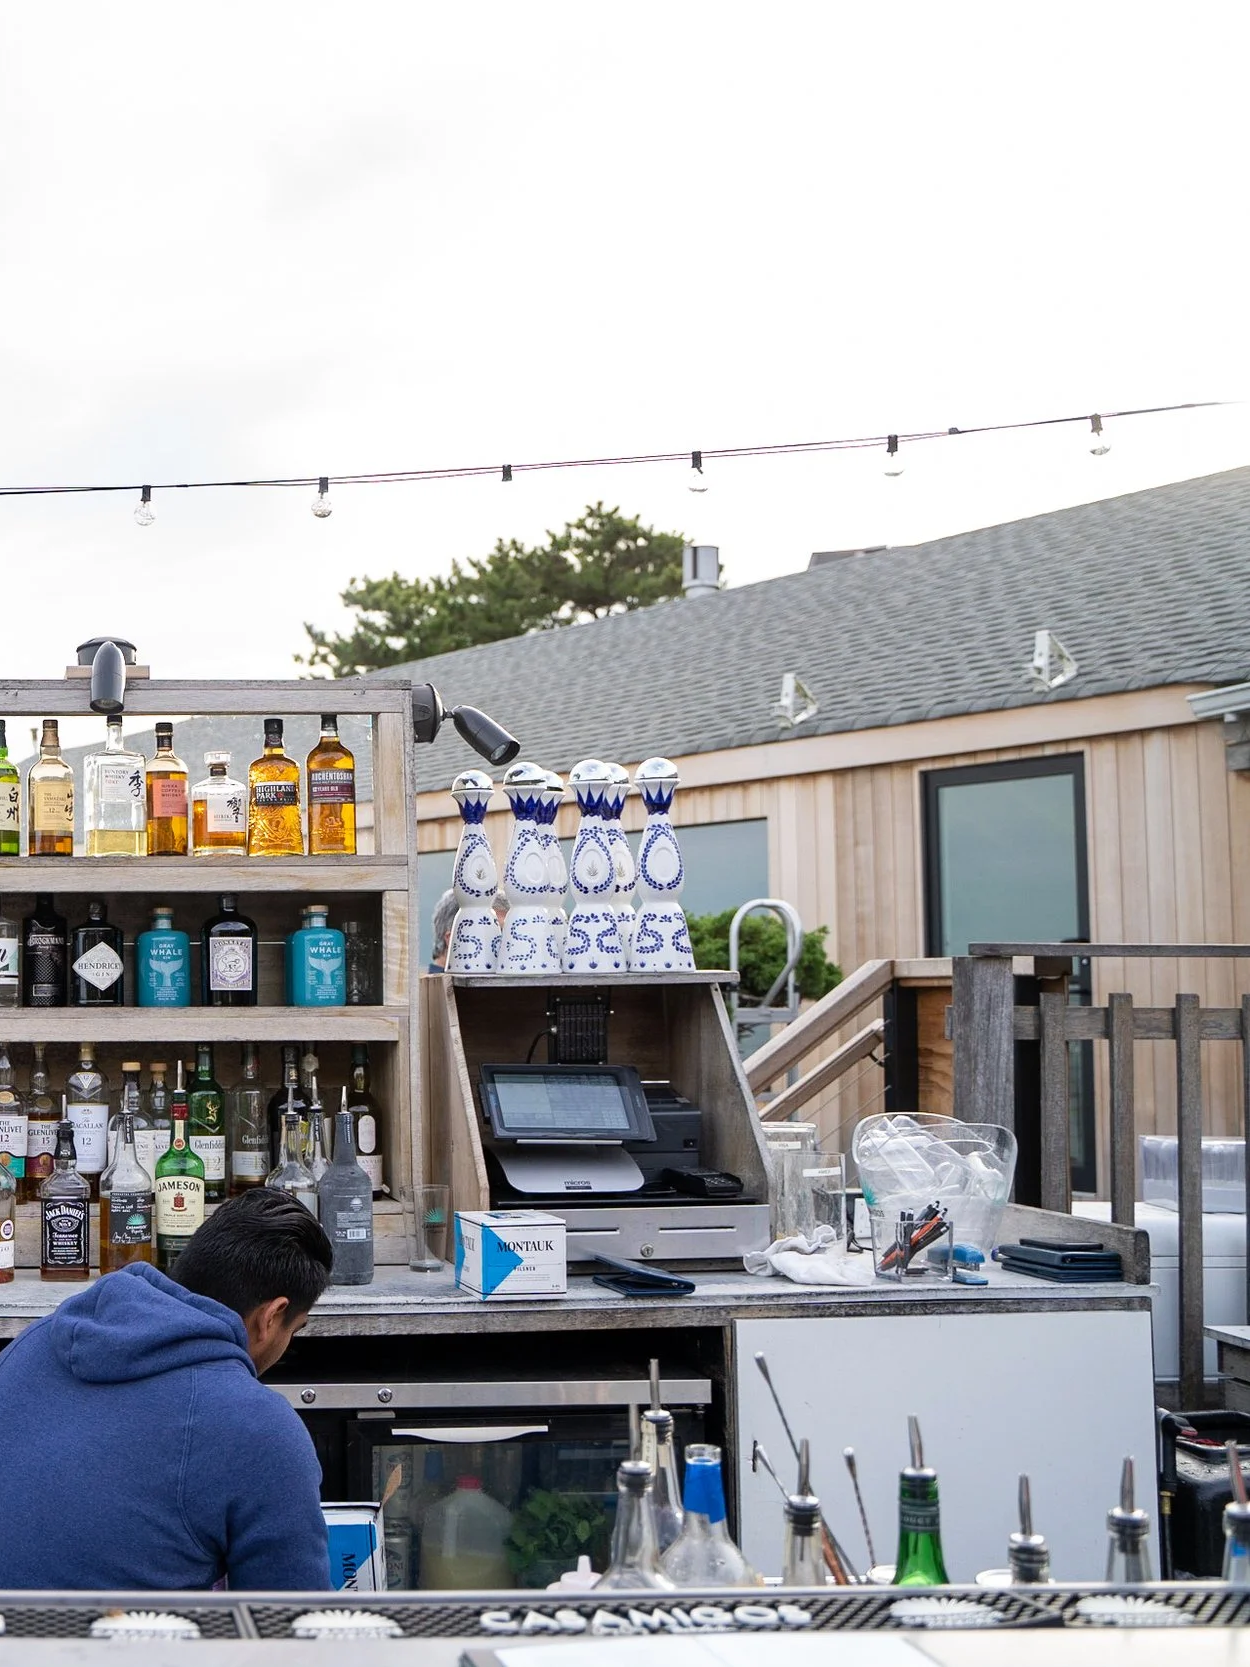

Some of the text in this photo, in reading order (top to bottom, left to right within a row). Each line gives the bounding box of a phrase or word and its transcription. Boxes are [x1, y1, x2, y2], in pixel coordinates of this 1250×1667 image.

[311, 772, 353, 781] AUCHENTOSHAN
[255, 785, 294, 793] HIGHLAND
[255, 792, 276, 800] PARK
[6, 787, 19, 823] 白州
[310, 946, 342, 954] WHALE
[82, 1137, 92, 1145] 12
[158, 1181, 200, 1192] JAMESON
[45, 1205, 85, 1220] JACK DANIEL'S
[497, 1240, 554, 1252] MONTAUK
[479, 1604, 812, 1631] CASAMIGOS
